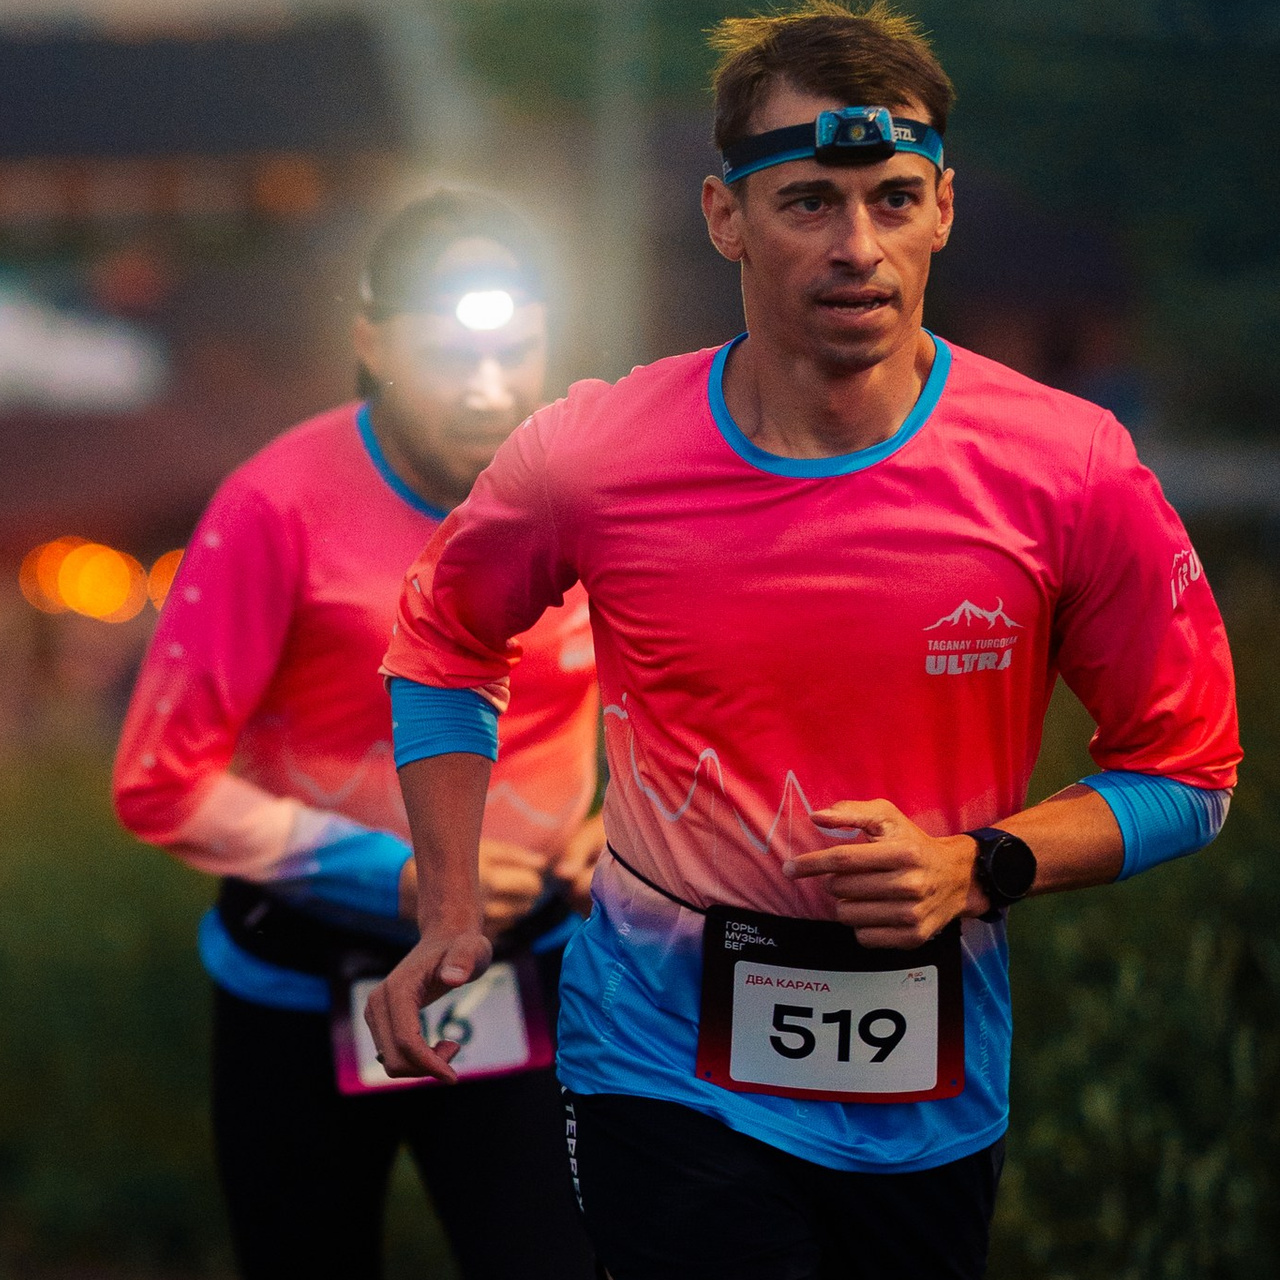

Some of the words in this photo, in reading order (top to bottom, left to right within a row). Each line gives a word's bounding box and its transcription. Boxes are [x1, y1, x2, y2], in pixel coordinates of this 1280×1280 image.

[893, 127, 918, 143] ETZL
[927, 639, 972, 651] TAGANAY
[925, 649, 1013, 675] ULTRA
[725, 920, 760, 935] ГОРЫ.
[724, 940, 746, 951] БЕГ
[725, 930, 778, 947] МУЗЫКА.
[745, 974, 774, 987] ДВА
[776, 978, 831, 992] КАРАТА
[769, 1003, 907, 1063] 519
